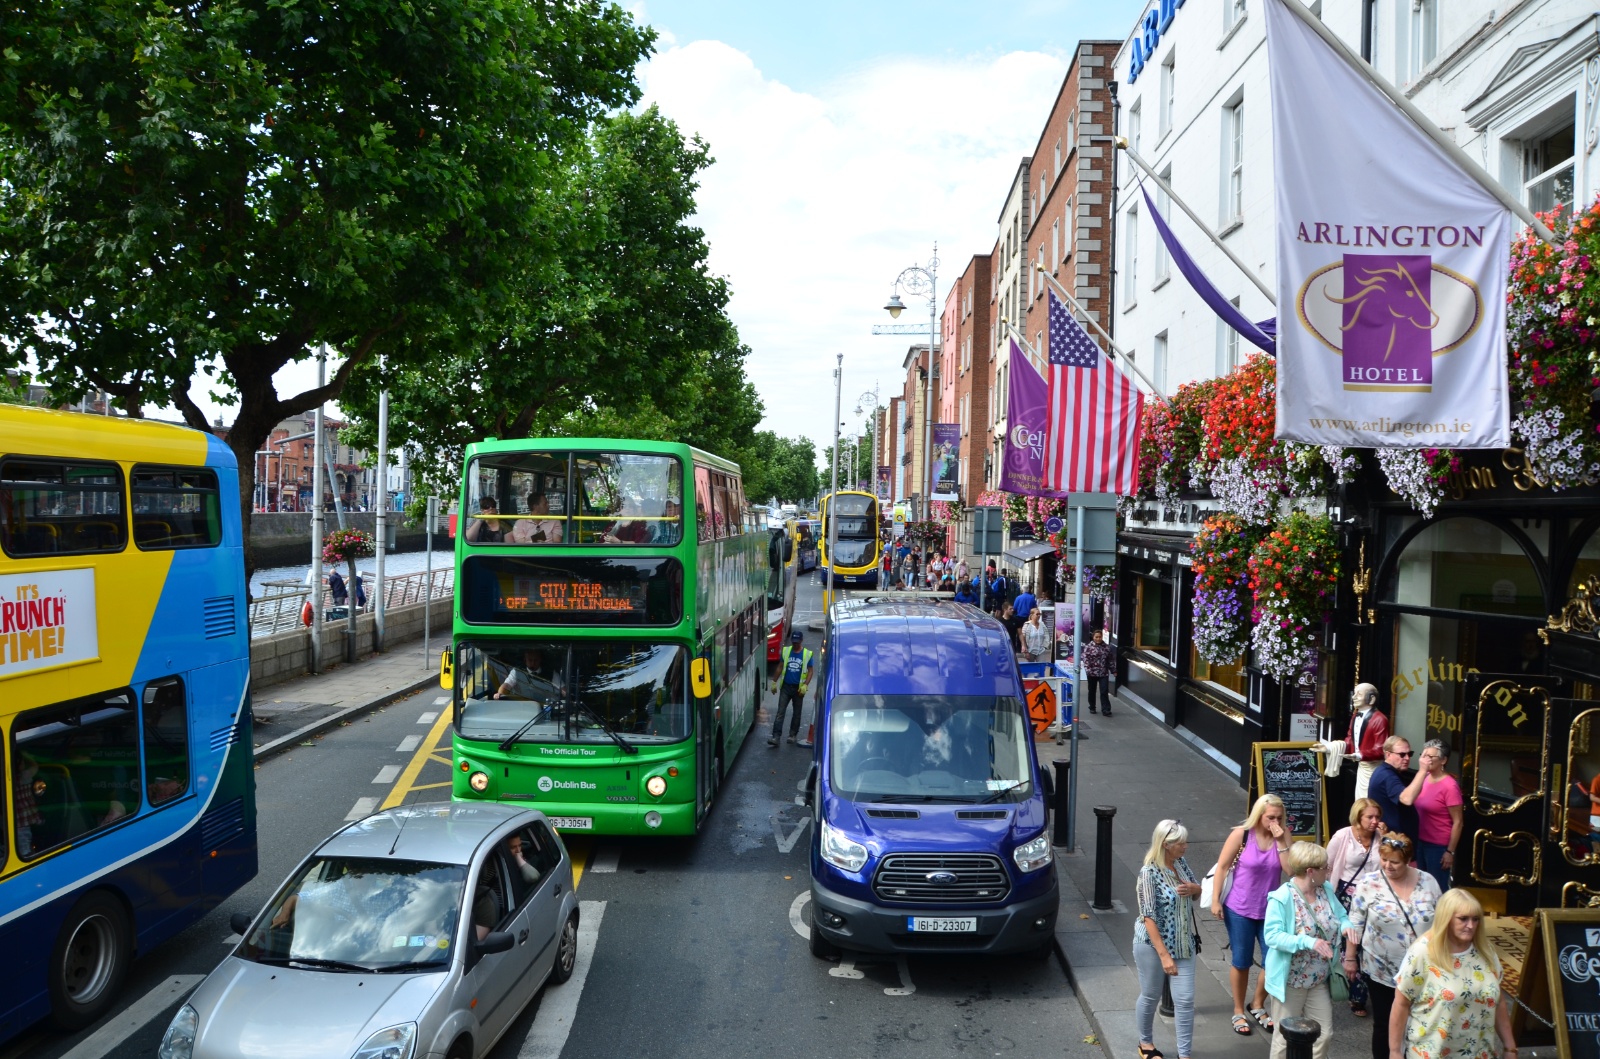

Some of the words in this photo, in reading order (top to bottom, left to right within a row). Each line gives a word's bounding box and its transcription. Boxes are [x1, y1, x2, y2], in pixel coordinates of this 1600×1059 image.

[1297, 221, 1486, 248] ARLINGTON
[1350, 366, 1423, 381] HOTEL
[1308, 416, 1472, 438] www.arlington.ie
[1017, 482, 1037, 490] Nights
[16, 583, 39, 601] IT'S
[540, 583, 567, 598] CITY
[571, 583, 602, 598] TOUR
[506, 597, 528, 609] OFF
[544, 597, 634, 610] MULTILINGUAL
[0, 596, 65, 633] RUNCH
[540, 747, 553, 755] The
[554, 747, 579, 755] Official
[580, 748, 597, 756] Tour
[553, 781, 580, 789] Dublin
[580, 781, 597, 789] Bus
[935, 874, 952, 883] Ford
[917, 920, 971, 931] 161-D-23307
[1566, 1014, 1600, 1030] TICKE
